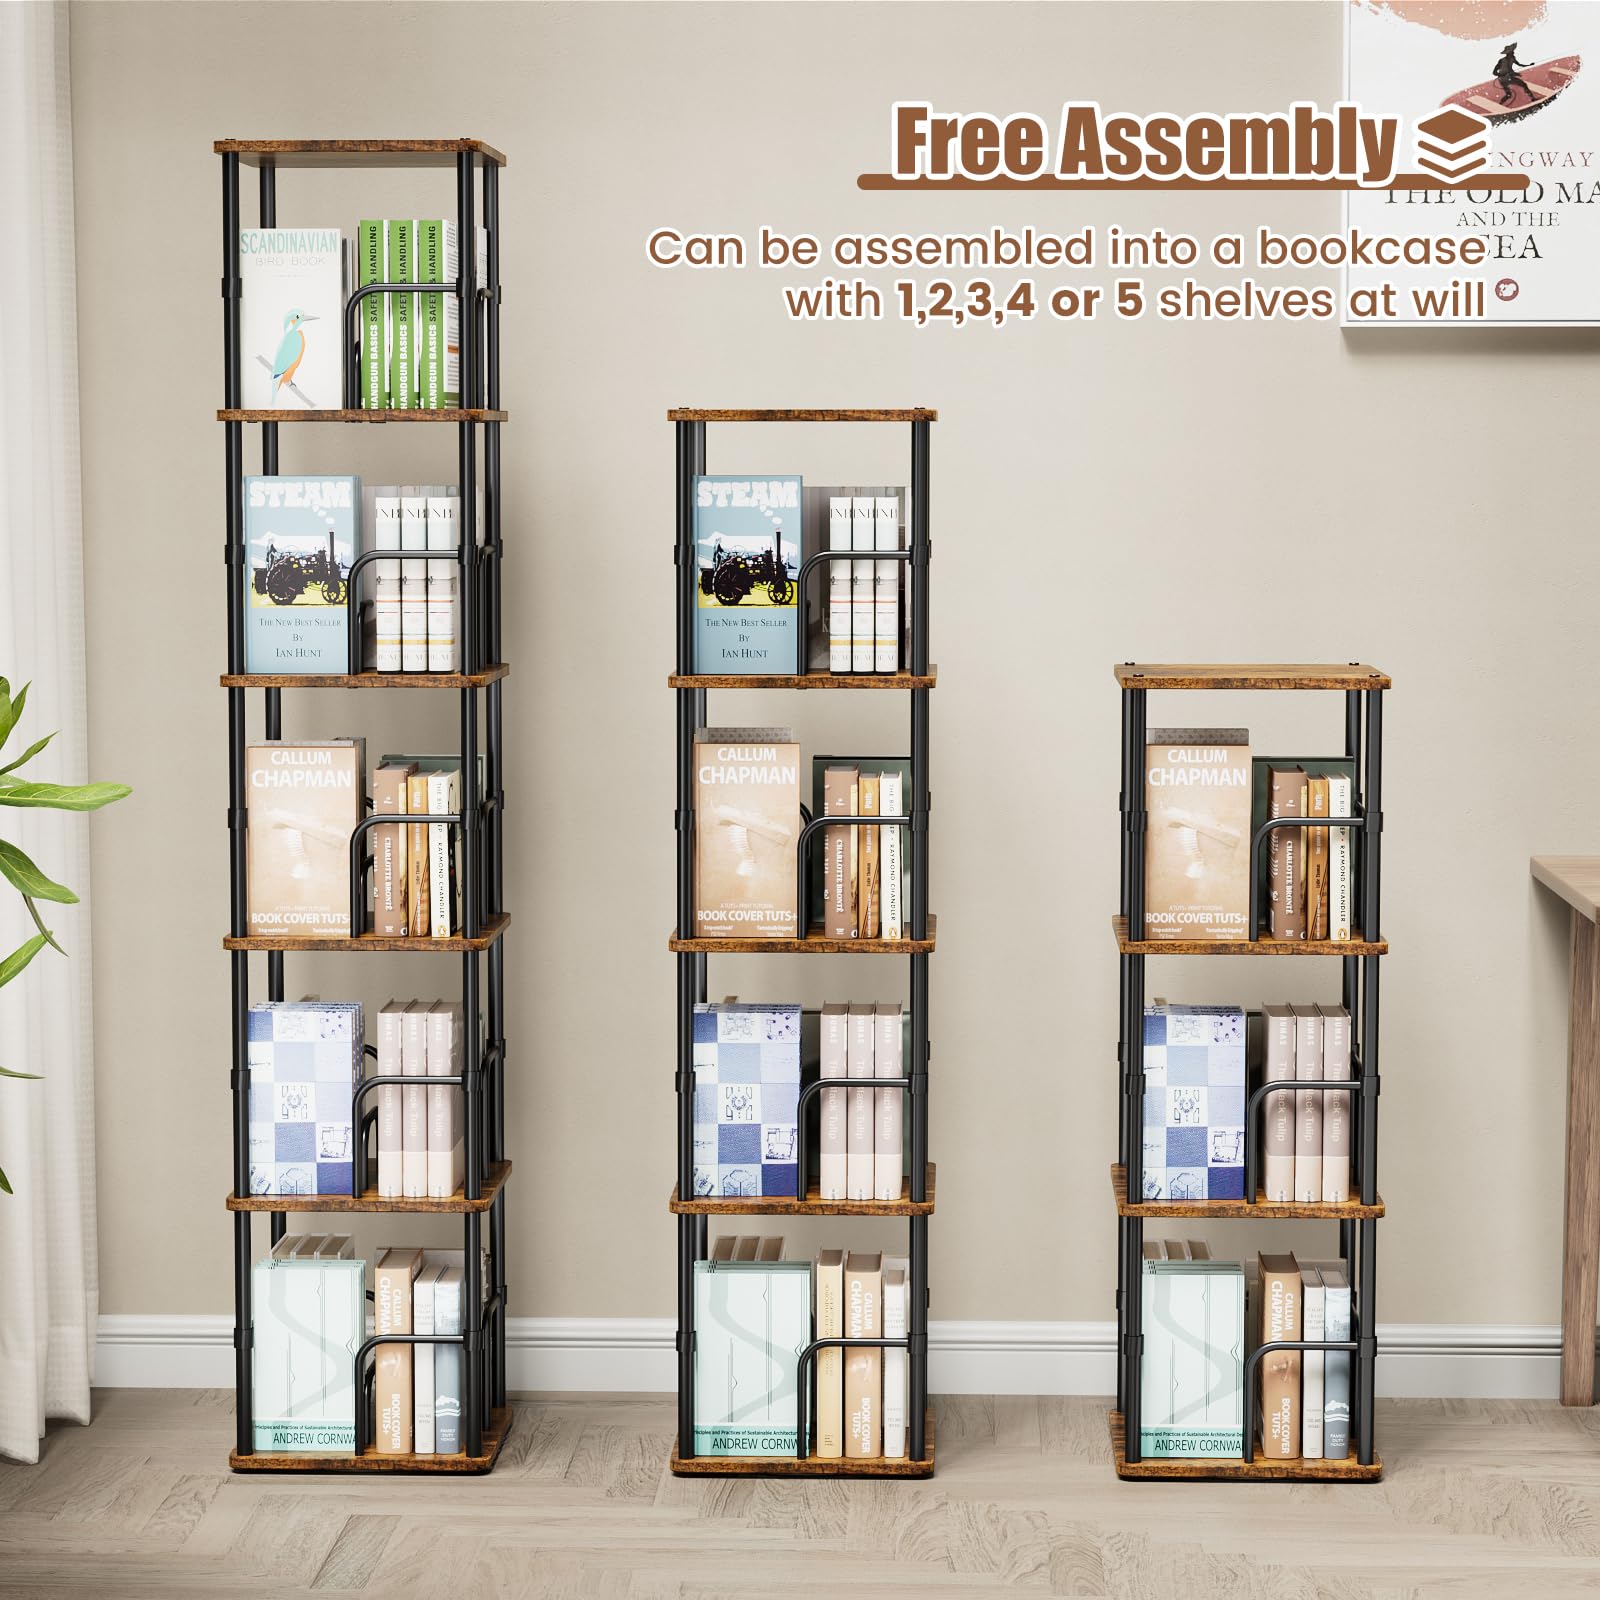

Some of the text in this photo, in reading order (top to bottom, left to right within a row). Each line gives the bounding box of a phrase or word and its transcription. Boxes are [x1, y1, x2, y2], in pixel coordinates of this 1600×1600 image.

[1456, 212, 1560, 227] AND THE
[241, 232, 338, 254] SCANDINAVIAN
[1480, 234, 1544, 259] EA
[256, 255, 326, 266] BIRD BOOK
[370, 324, 378, 360] BASICS
[400, 324, 408, 360] BASICS
[429, 324, 437, 360] BASICS
[370, 362, 378, 409] HANDGUN
[400, 362, 408, 409] HANDGUN
[429, 362, 437, 409] HANDGUN
[249, 481, 351, 508] STEAM
[697, 480, 798, 508] STEAM
[271, 751, 332, 765] CALLUM
[717, 747, 777, 762] CALLUM
[1167, 749, 1228, 763] CALLUM
[251, 769, 351, 788] CHAPMAN
[699, 766, 796, 785] CHAPMAN
[1148, 767, 1247, 786] CHAPMAN
[384, 837, 392, 881] CHARLOTTE
[251, 912, 350, 924] BOOK COVER TUTS
[697, 910, 727, 921] BOOK
[728, 910, 764, 921] COVER
[1146, 912, 1176, 924] BOOK
[1176, 912, 1213, 924] COVER
[1279, 1090, 1287, 1113] lack
[1306, 1090, 1314, 1113] lack
[1334, 1090, 1342, 1113] lack
[1278, 1117, 1287, 1142] Tulip
[1305, 1117, 1314, 1142] Tulip
[1332, 1117, 1342, 1142] Tulip
[393, 1289, 401, 1327] CALLUM
[864, 1293, 872, 1330] CALLUM
[1285, 1293, 1293, 1330] CALLUM
[383, 1408, 391, 1436] TUTS+
[391, 1394, 400, 1449] BOOK COVER
[852, 1412, 861, 1439] TUTS+
[862, 1398, 871, 1453] BOOK COVER
[1272, 1411, 1280, 1440] TUTS+
[1281, 1398, 1290, 1454] BOOK COVER
[273, 1432, 315, 1444] ANDREW
[712, 1438, 758, 1449] ANDREW
[1155, 1440, 1197, 1451] ANDREW
